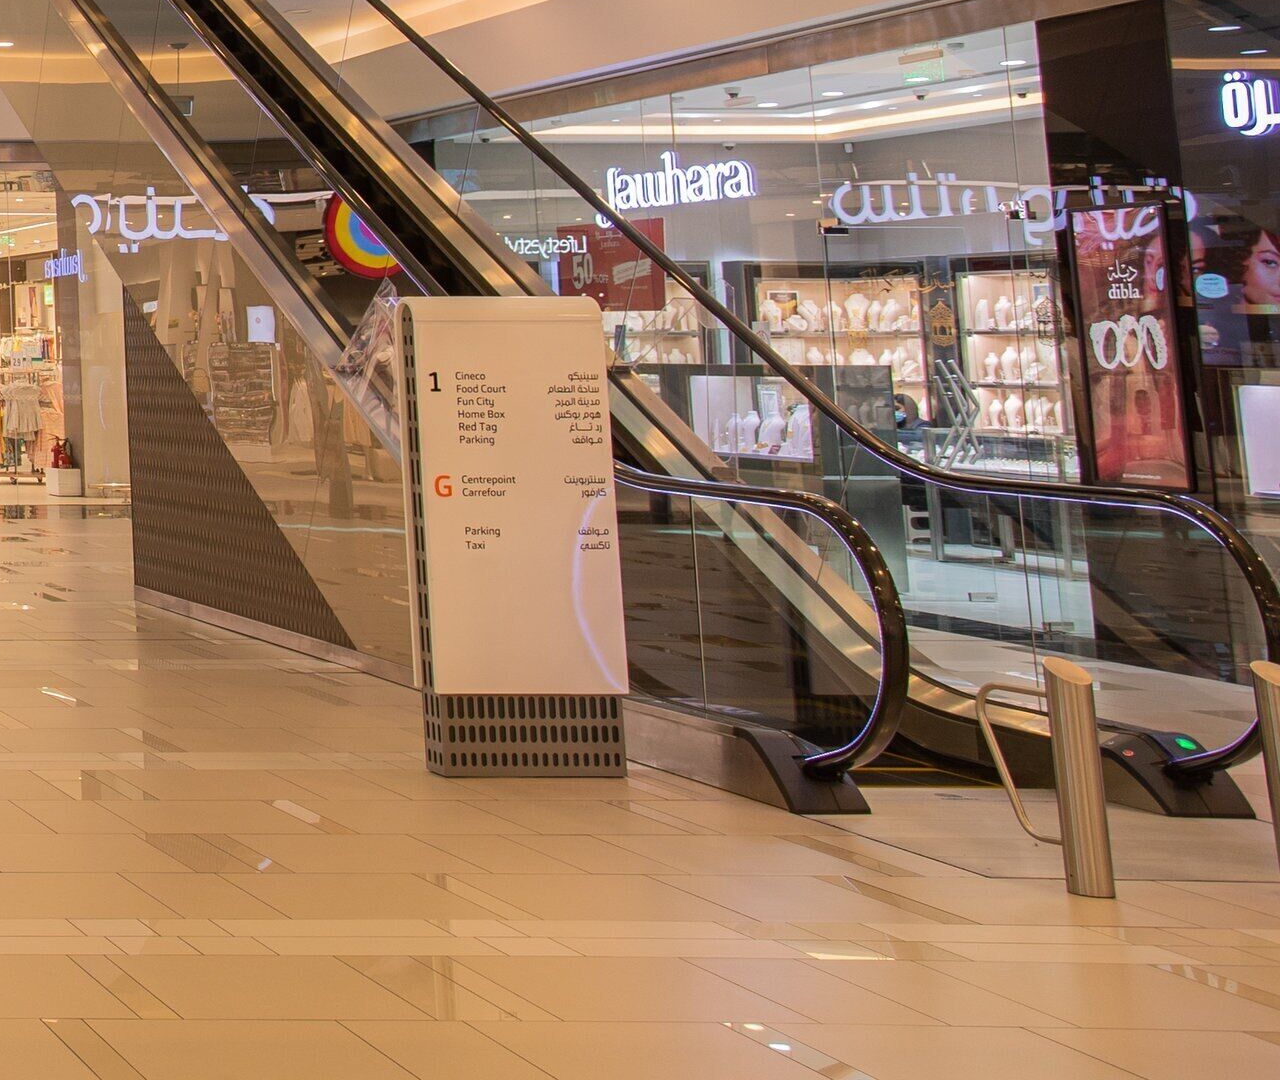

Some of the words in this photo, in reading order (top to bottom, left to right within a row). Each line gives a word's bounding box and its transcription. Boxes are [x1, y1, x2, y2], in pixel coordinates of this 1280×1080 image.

[1108, 283, 1140, 300] dibla
[429, 371, 441, 392] 1
[455, 371, 486, 380] Cineco
[568, 371, 599, 382] سينيكو
[456, 384, 478, 393] Food
[481, 384, 506, 393] Court
[547, 384, 575, 395] الطعام
[577, 384, 600, 393] ساحة
[457, 397, 474, 406] Fun
[476, 397, 495, 408] City
[555, 397, 576, 407] المرح
[577, 397, 601, 407] مدينة
[457, 410, 485, 418] Home
[487, 410, 505, 418] Box
[555, 409, 581, 420] بوكس
[582, 411, 601, 420] هوم
[458, 422, 477, 431] Red
[479, 422, 497, 433] Tag
[459, 435, 495, 446] Parking
[434, 475, 453, 497] G
[461, 475, 516, 485] Centrepoint
[462, 488, 506, 497] Carrefour
[581, 487, 607, 498] كارفور
[464, 526, 501, 537] Parking
[465, 541, 486, 549] Taxi
[580, 540, 610, 551] تاكسي
